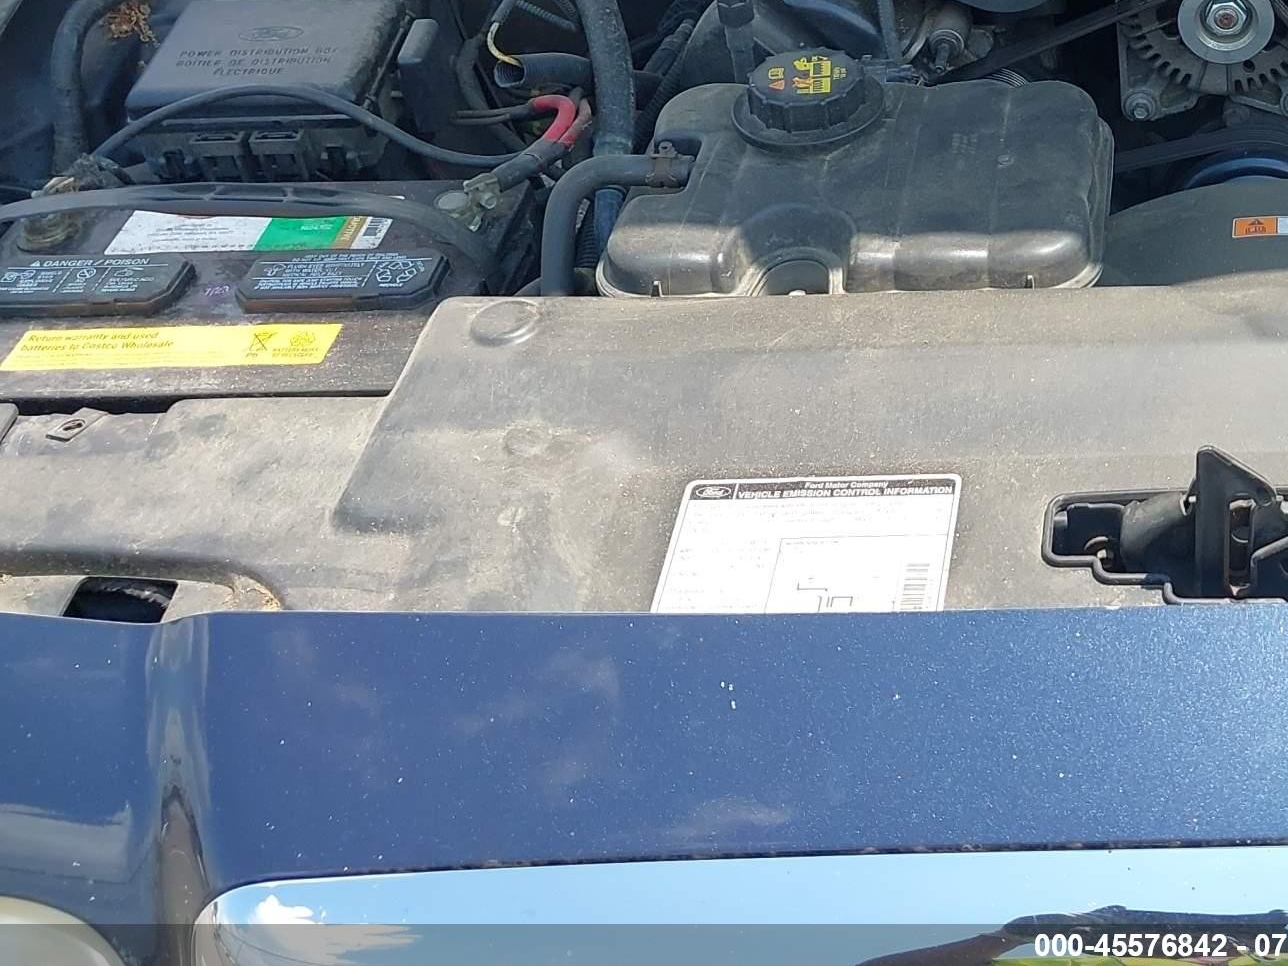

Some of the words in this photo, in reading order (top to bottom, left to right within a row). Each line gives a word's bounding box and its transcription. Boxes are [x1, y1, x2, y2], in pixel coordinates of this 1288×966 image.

[179, 49, 223, 58] POWER
[230, 47, 309, 57] DISTRIBUTION
[251, 57, 331, 66] DISTRIBUTION
[28, 334, 63, 342] Return
[65, 334, 109, 342] warranty
[111, 332, 130, 340] and
[133, 332, 160, 340] used
[20, 343, 66, 352] batteries
[69, 343, 79, 351] to
[121, 340, 175, 349] Wholesale
[825, 481, 849, 489] Motor
[850, 481, 889, 490] Company
[738, 490, 782, 500] VEHICLE
[783, 489, 831, 498] EMISSION
[833, 488, 881, 497] CONTROL
[883, 486, 953, 495] INFORMATION
